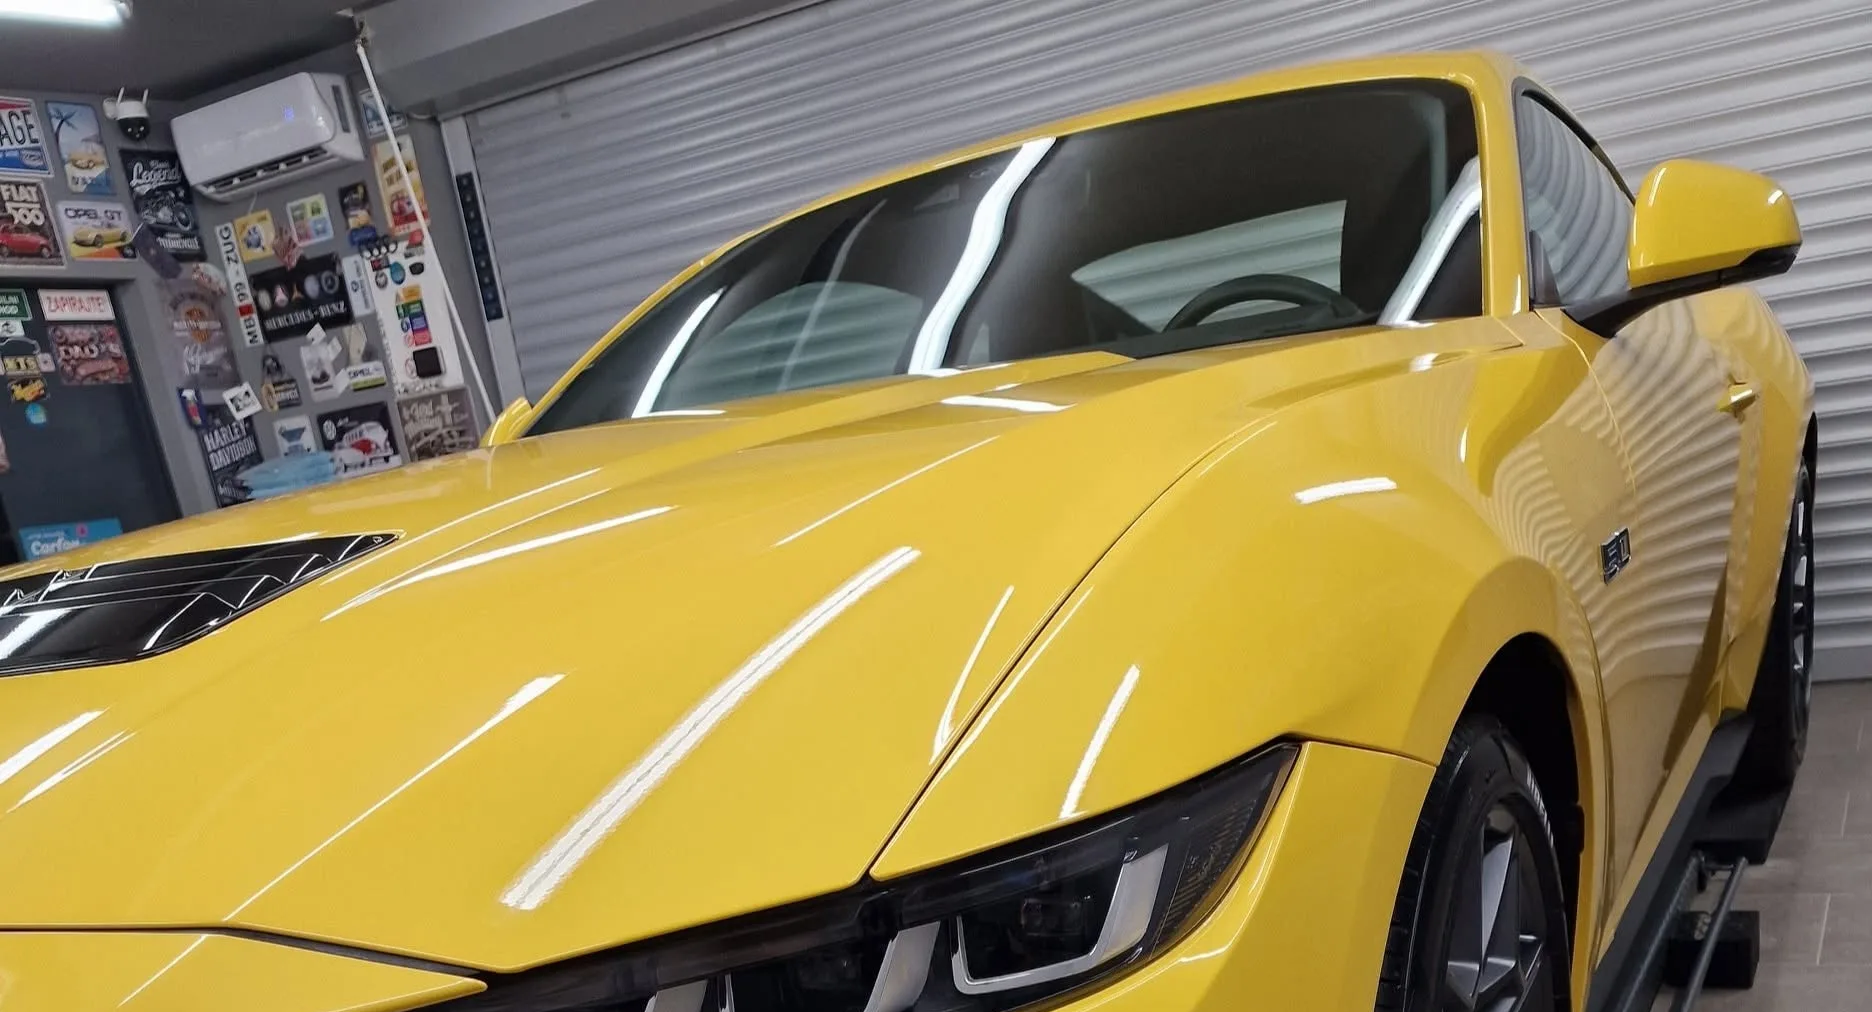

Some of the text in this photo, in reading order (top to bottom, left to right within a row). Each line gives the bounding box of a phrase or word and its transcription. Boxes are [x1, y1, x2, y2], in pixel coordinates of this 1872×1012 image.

[1, 184, 39, 201] FIAT
[104, 210, 122, 221] GT
[220, 226, 238, 264] ZUG
